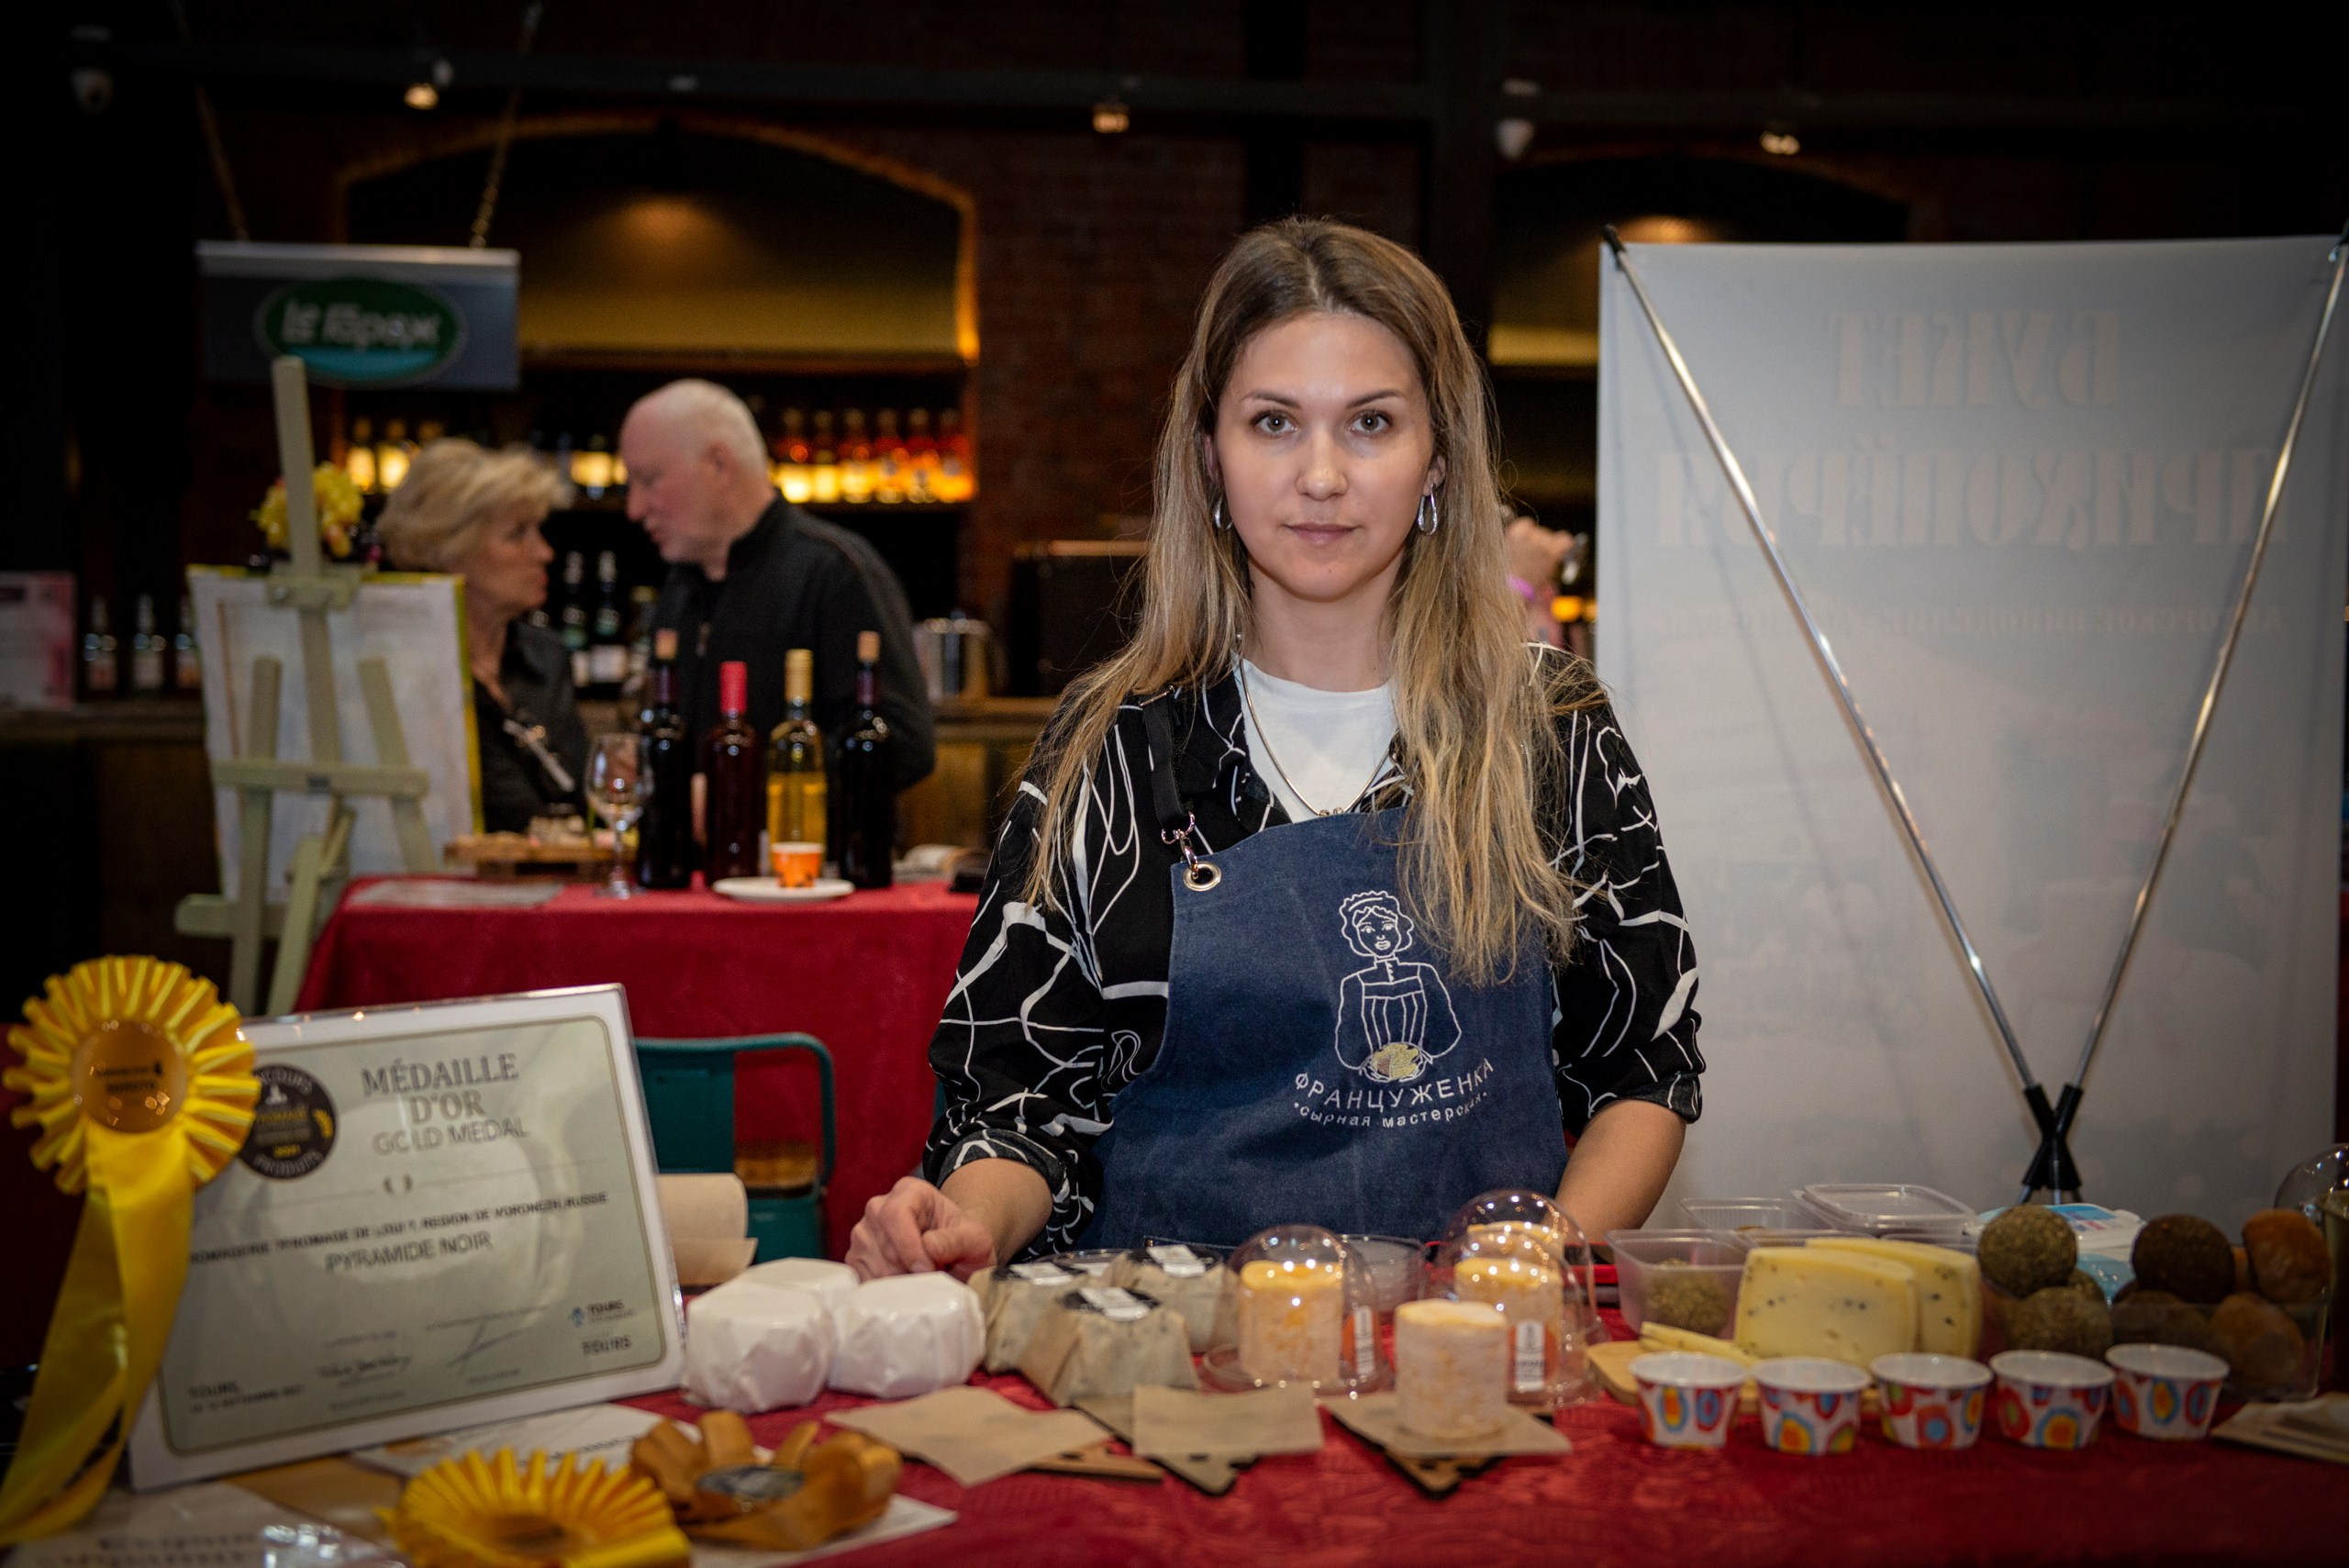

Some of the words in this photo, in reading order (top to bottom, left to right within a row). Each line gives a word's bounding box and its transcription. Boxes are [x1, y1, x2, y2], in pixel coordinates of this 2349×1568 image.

[362, 1052, 519, 1095] MÉDAILLE
[1295, 1058, 1494, 1113] ФРАНЦУЖЕНКА
[410, 1090, 485, 1124] D'OR
[1299, 1104, 1371, 1128] сырная
[372, 1126, 444, 1156] GOLD
[447, 1117, 530, 1146] MEDAL
[190, 1242, 270, 1265] ROMAGERIE
[355, 1226, 371, 1240] DE
[422, 1210, 471, 1230] REGION
[475, 1208, 490, 1223] DE
[565, 1191, 608, 1209] RUSSIE
[324, 1242, 435, 1273] PYRAMIDE
[439, 1229, 493, 1257] NOIR
[581, 1336, 631, 1356] TOURS
